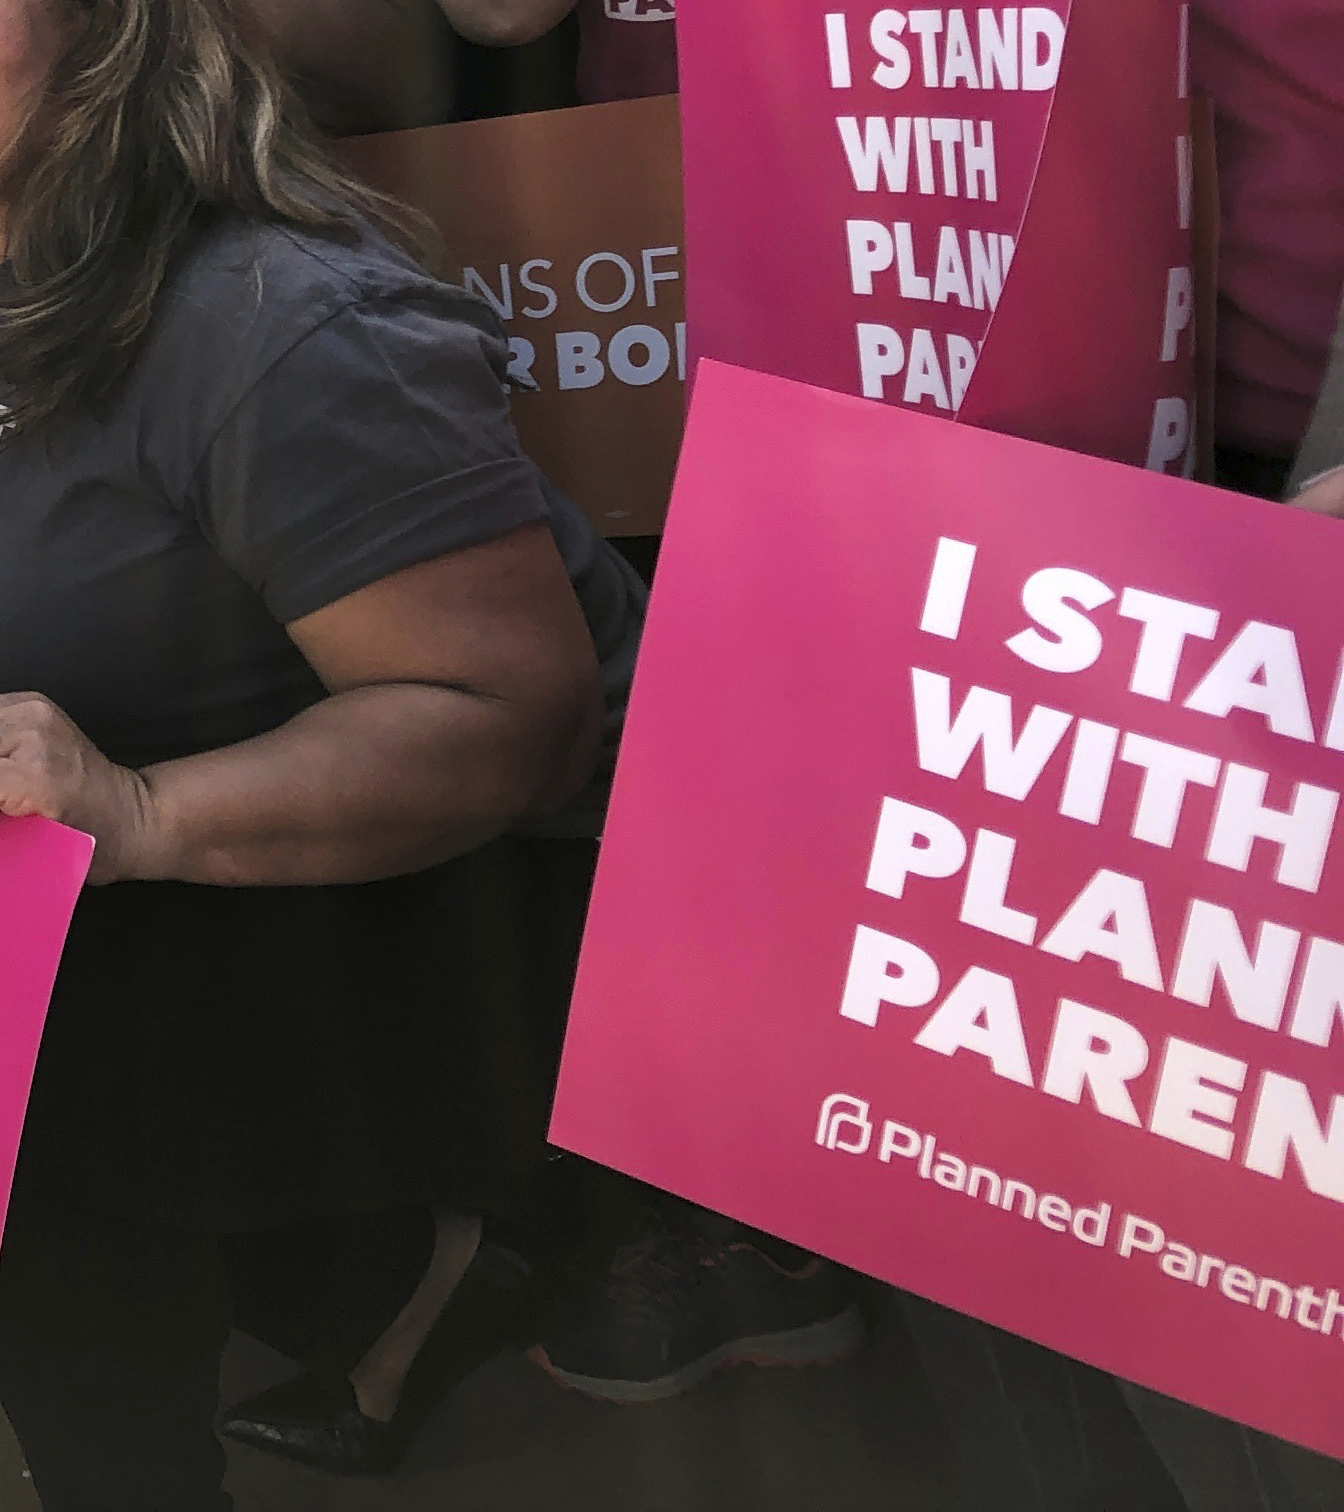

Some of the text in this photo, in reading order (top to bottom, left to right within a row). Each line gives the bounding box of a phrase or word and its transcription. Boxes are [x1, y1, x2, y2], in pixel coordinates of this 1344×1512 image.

[824, 7, 1067, 91] I STAND
[836, 115, 998, 202] WITH
[845, 219, 1016, 313] PLAN
[462, 245, 679, 321] NS OF
[917, 536, 1344, 753] I STA
[910, 666, 1340, 894] WITH
[864, 796, 1344, 1050] PLAN
[838, 923, 1344, 1205] PAREN
[877, 1120, 1344, 1341] Planned Parenth
